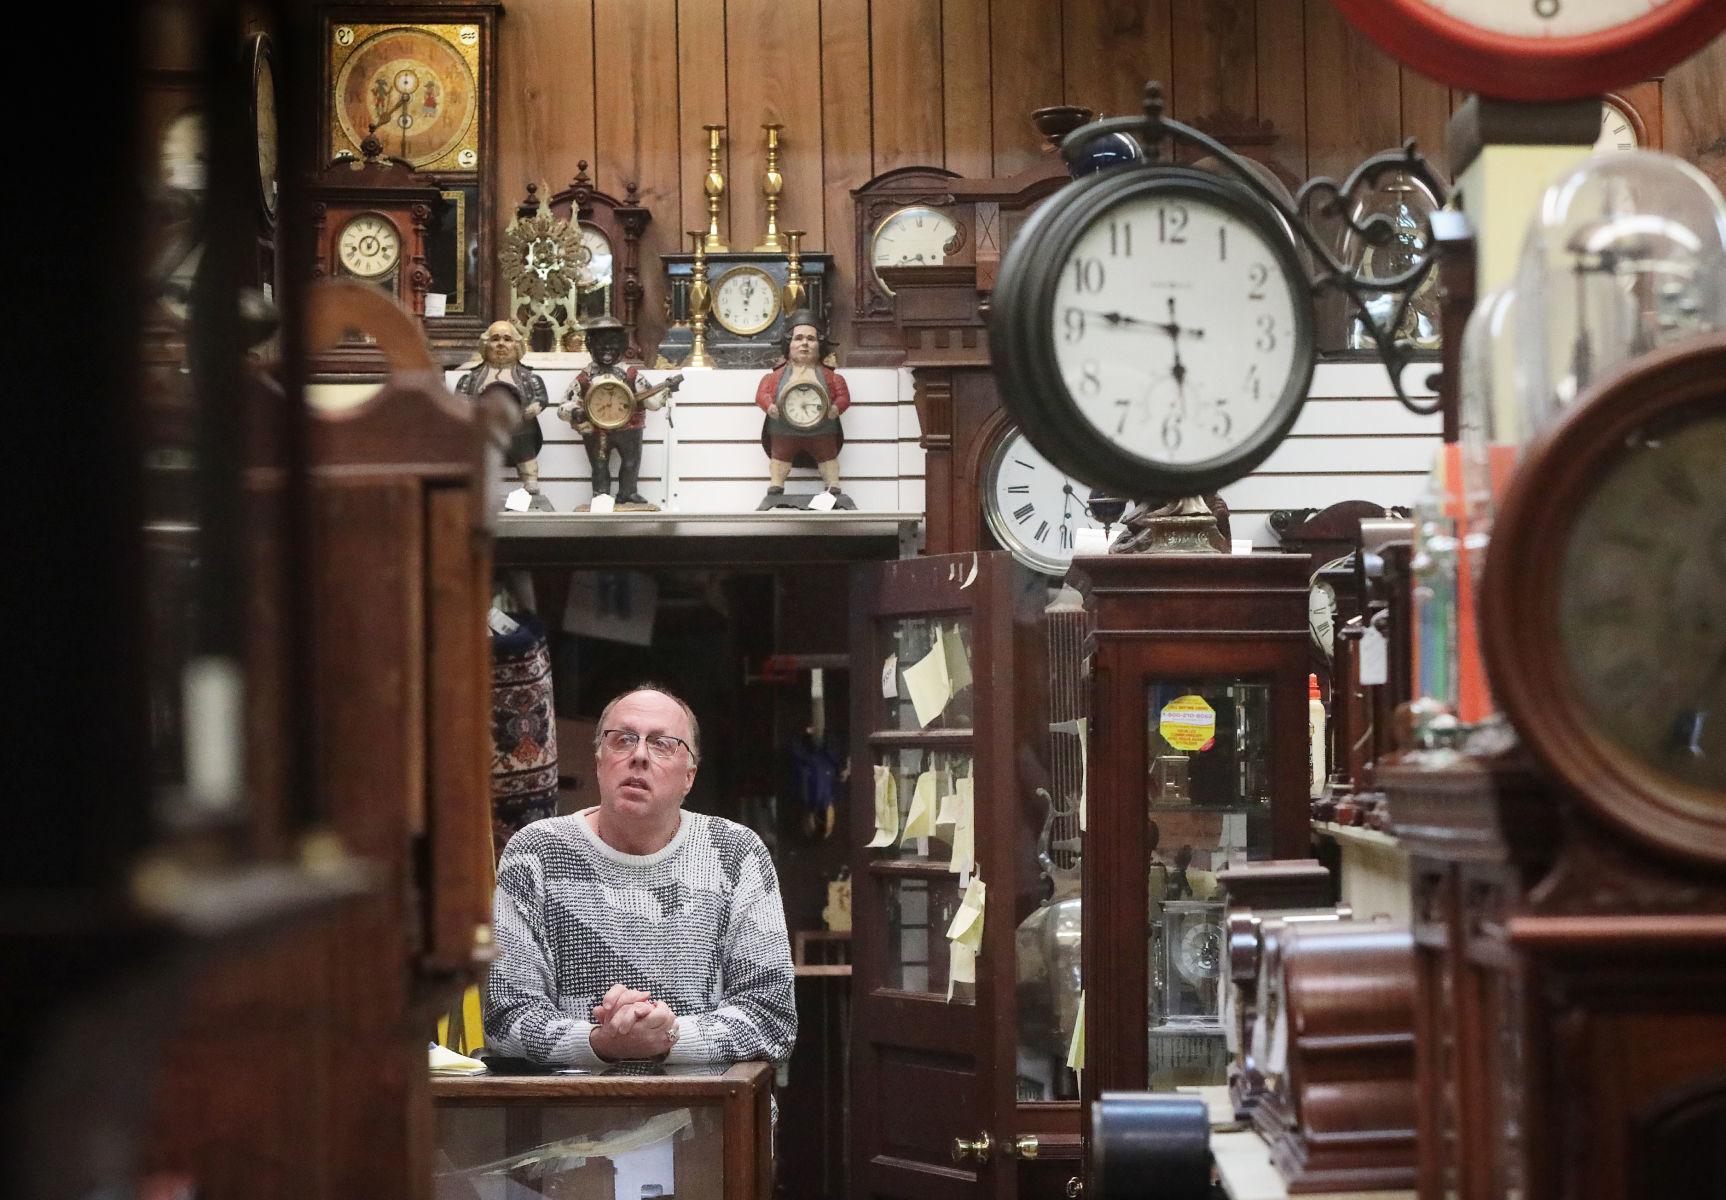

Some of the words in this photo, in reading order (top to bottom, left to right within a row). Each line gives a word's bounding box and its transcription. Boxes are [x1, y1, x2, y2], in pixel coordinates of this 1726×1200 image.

[1110, 221, 1132, 257] 11
[1158, 205, 1189, 243] 12
[1219, 226, 1227, 262] 1
[1073, 257, 1105, 293] 10
[1248, 263, 1269, 300] 2
[1063, 307, 1086, 344] 9
[1255, 315, 1277, 352] 3
[1078, 361, 1100, 396] 8
[1244, 364, 1260, 400] 4
[1114, 399, 1131, 434] 7
[1161, 411, 1182, 450] 6
[1212, 399, 1232, 437] 5
